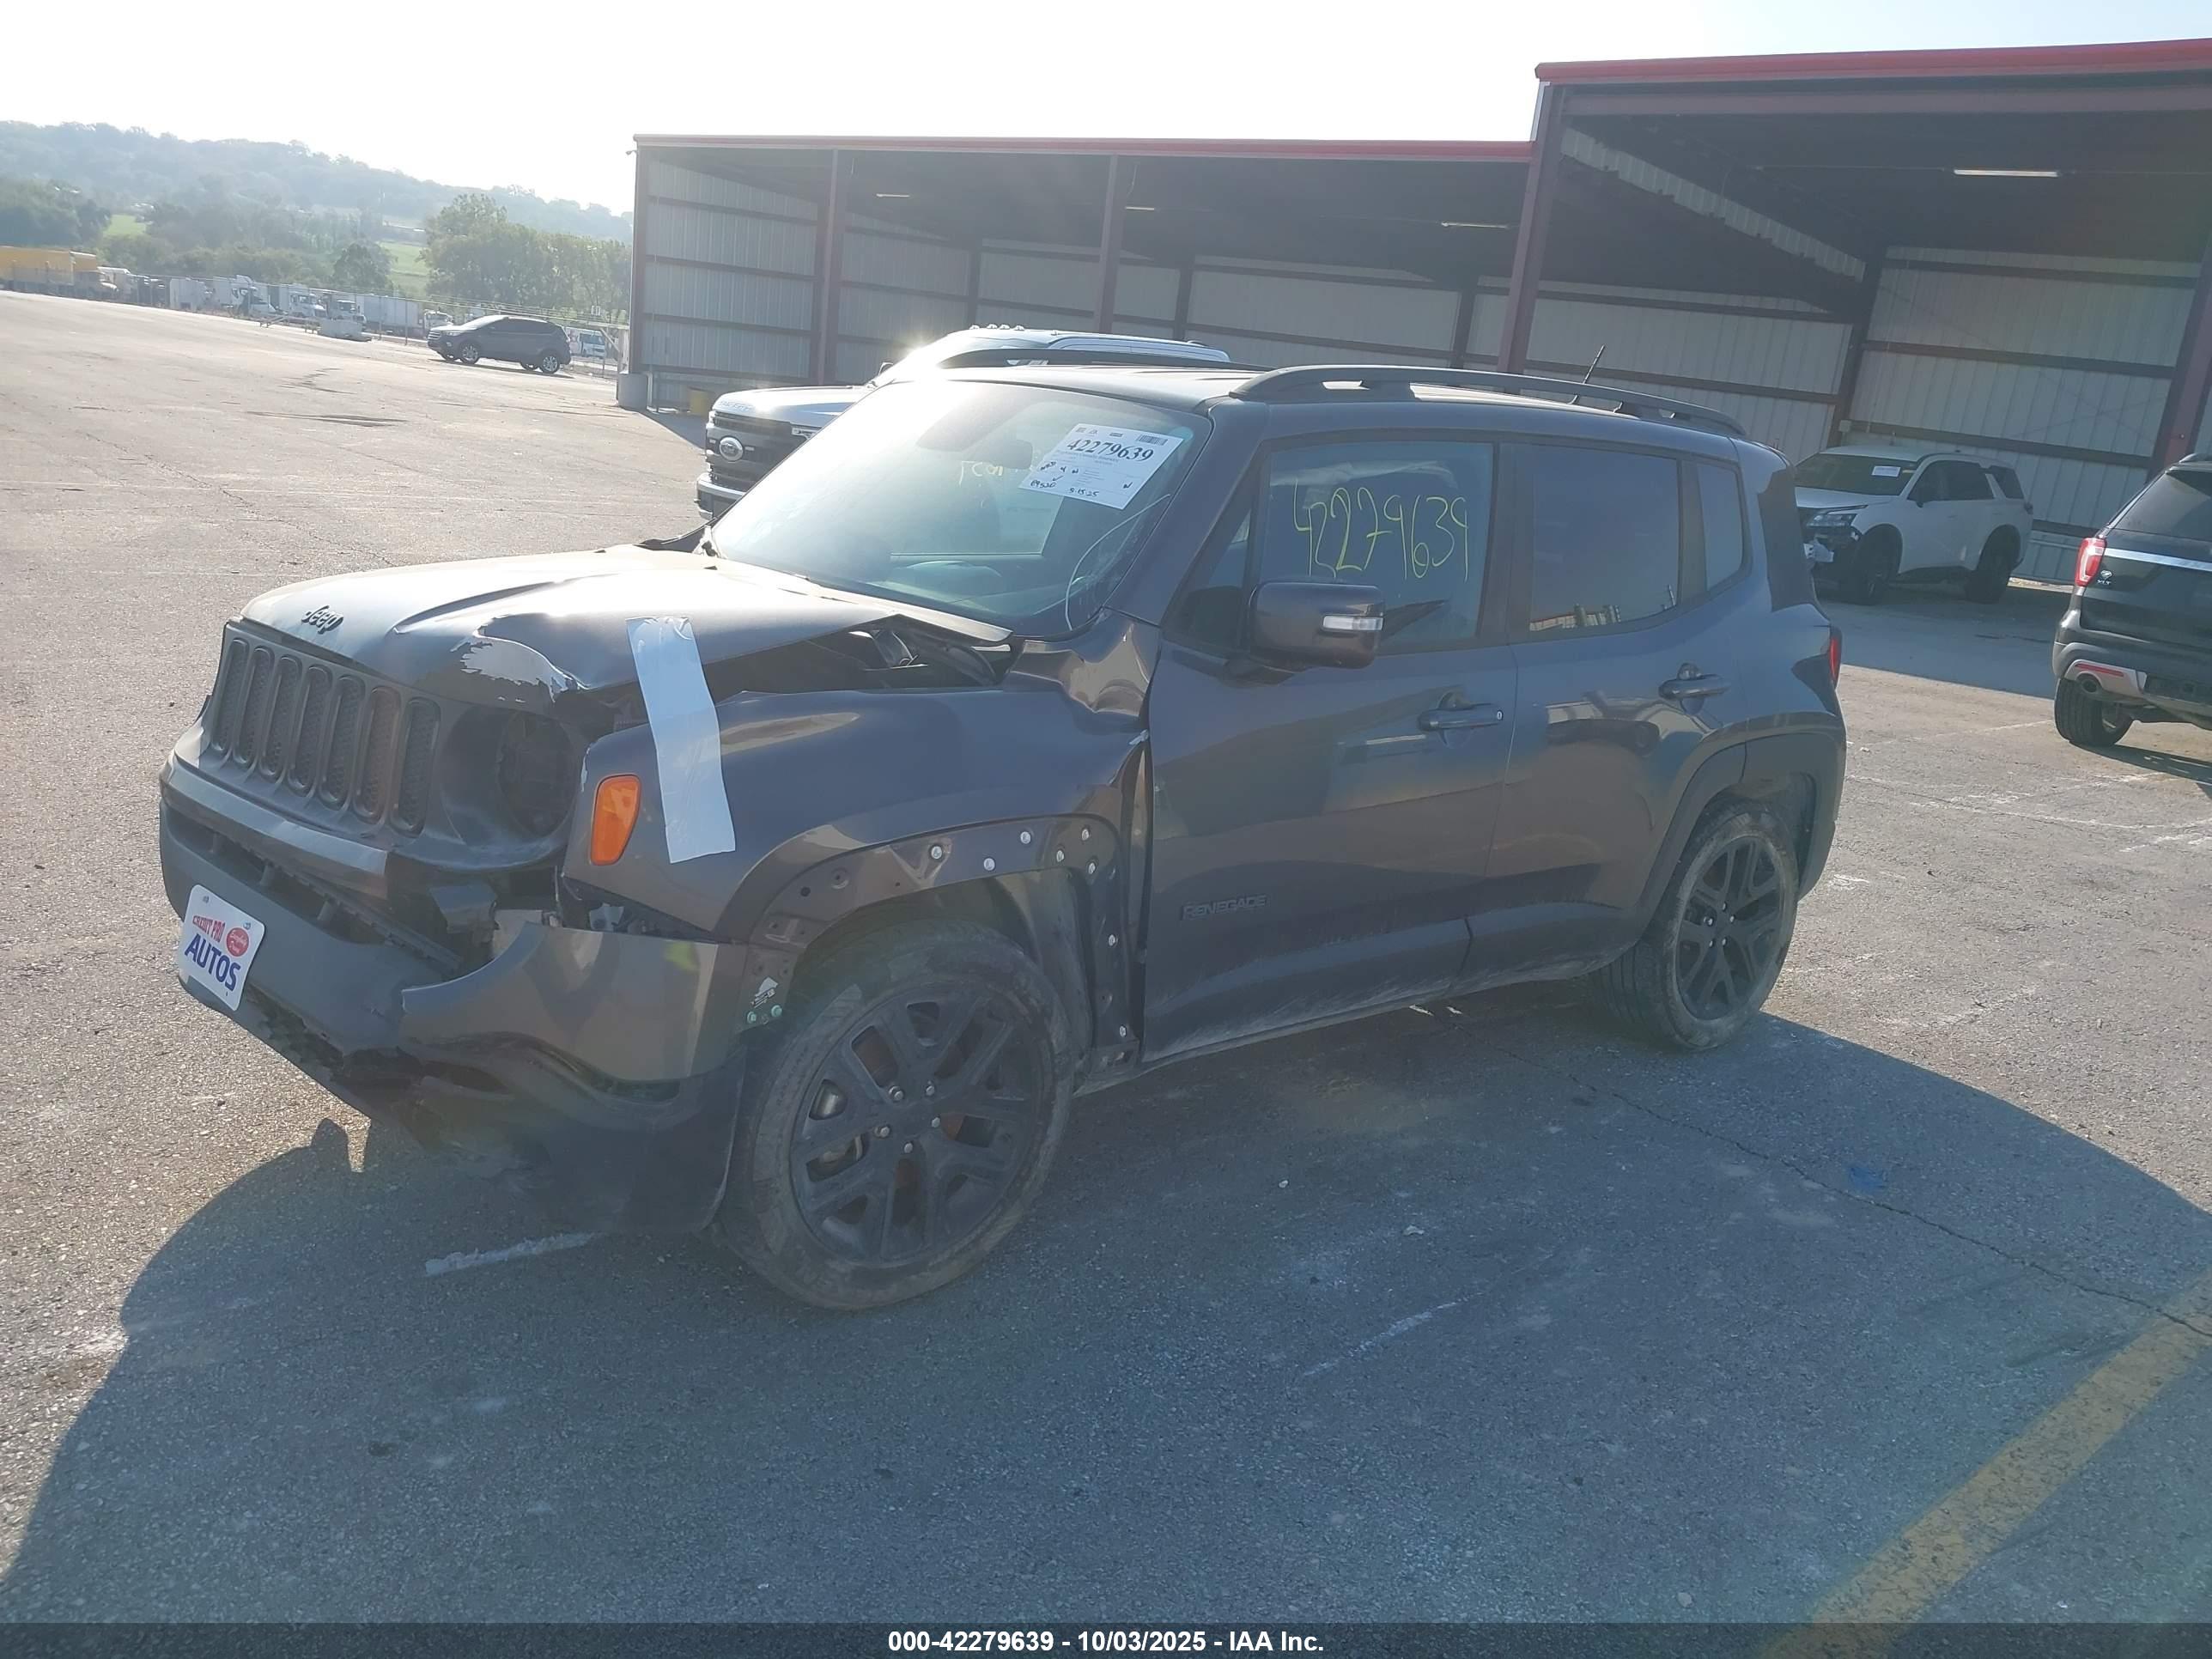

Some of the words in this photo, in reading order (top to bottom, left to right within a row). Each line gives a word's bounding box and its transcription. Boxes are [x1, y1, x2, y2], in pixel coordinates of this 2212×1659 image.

[1066, 439, 1154, 462] 42279639
[1294, 478, 1469, 582] 42279639
[301, 605, 343, 635] Jeep
[184, 933, 241, 992] AUTOS
